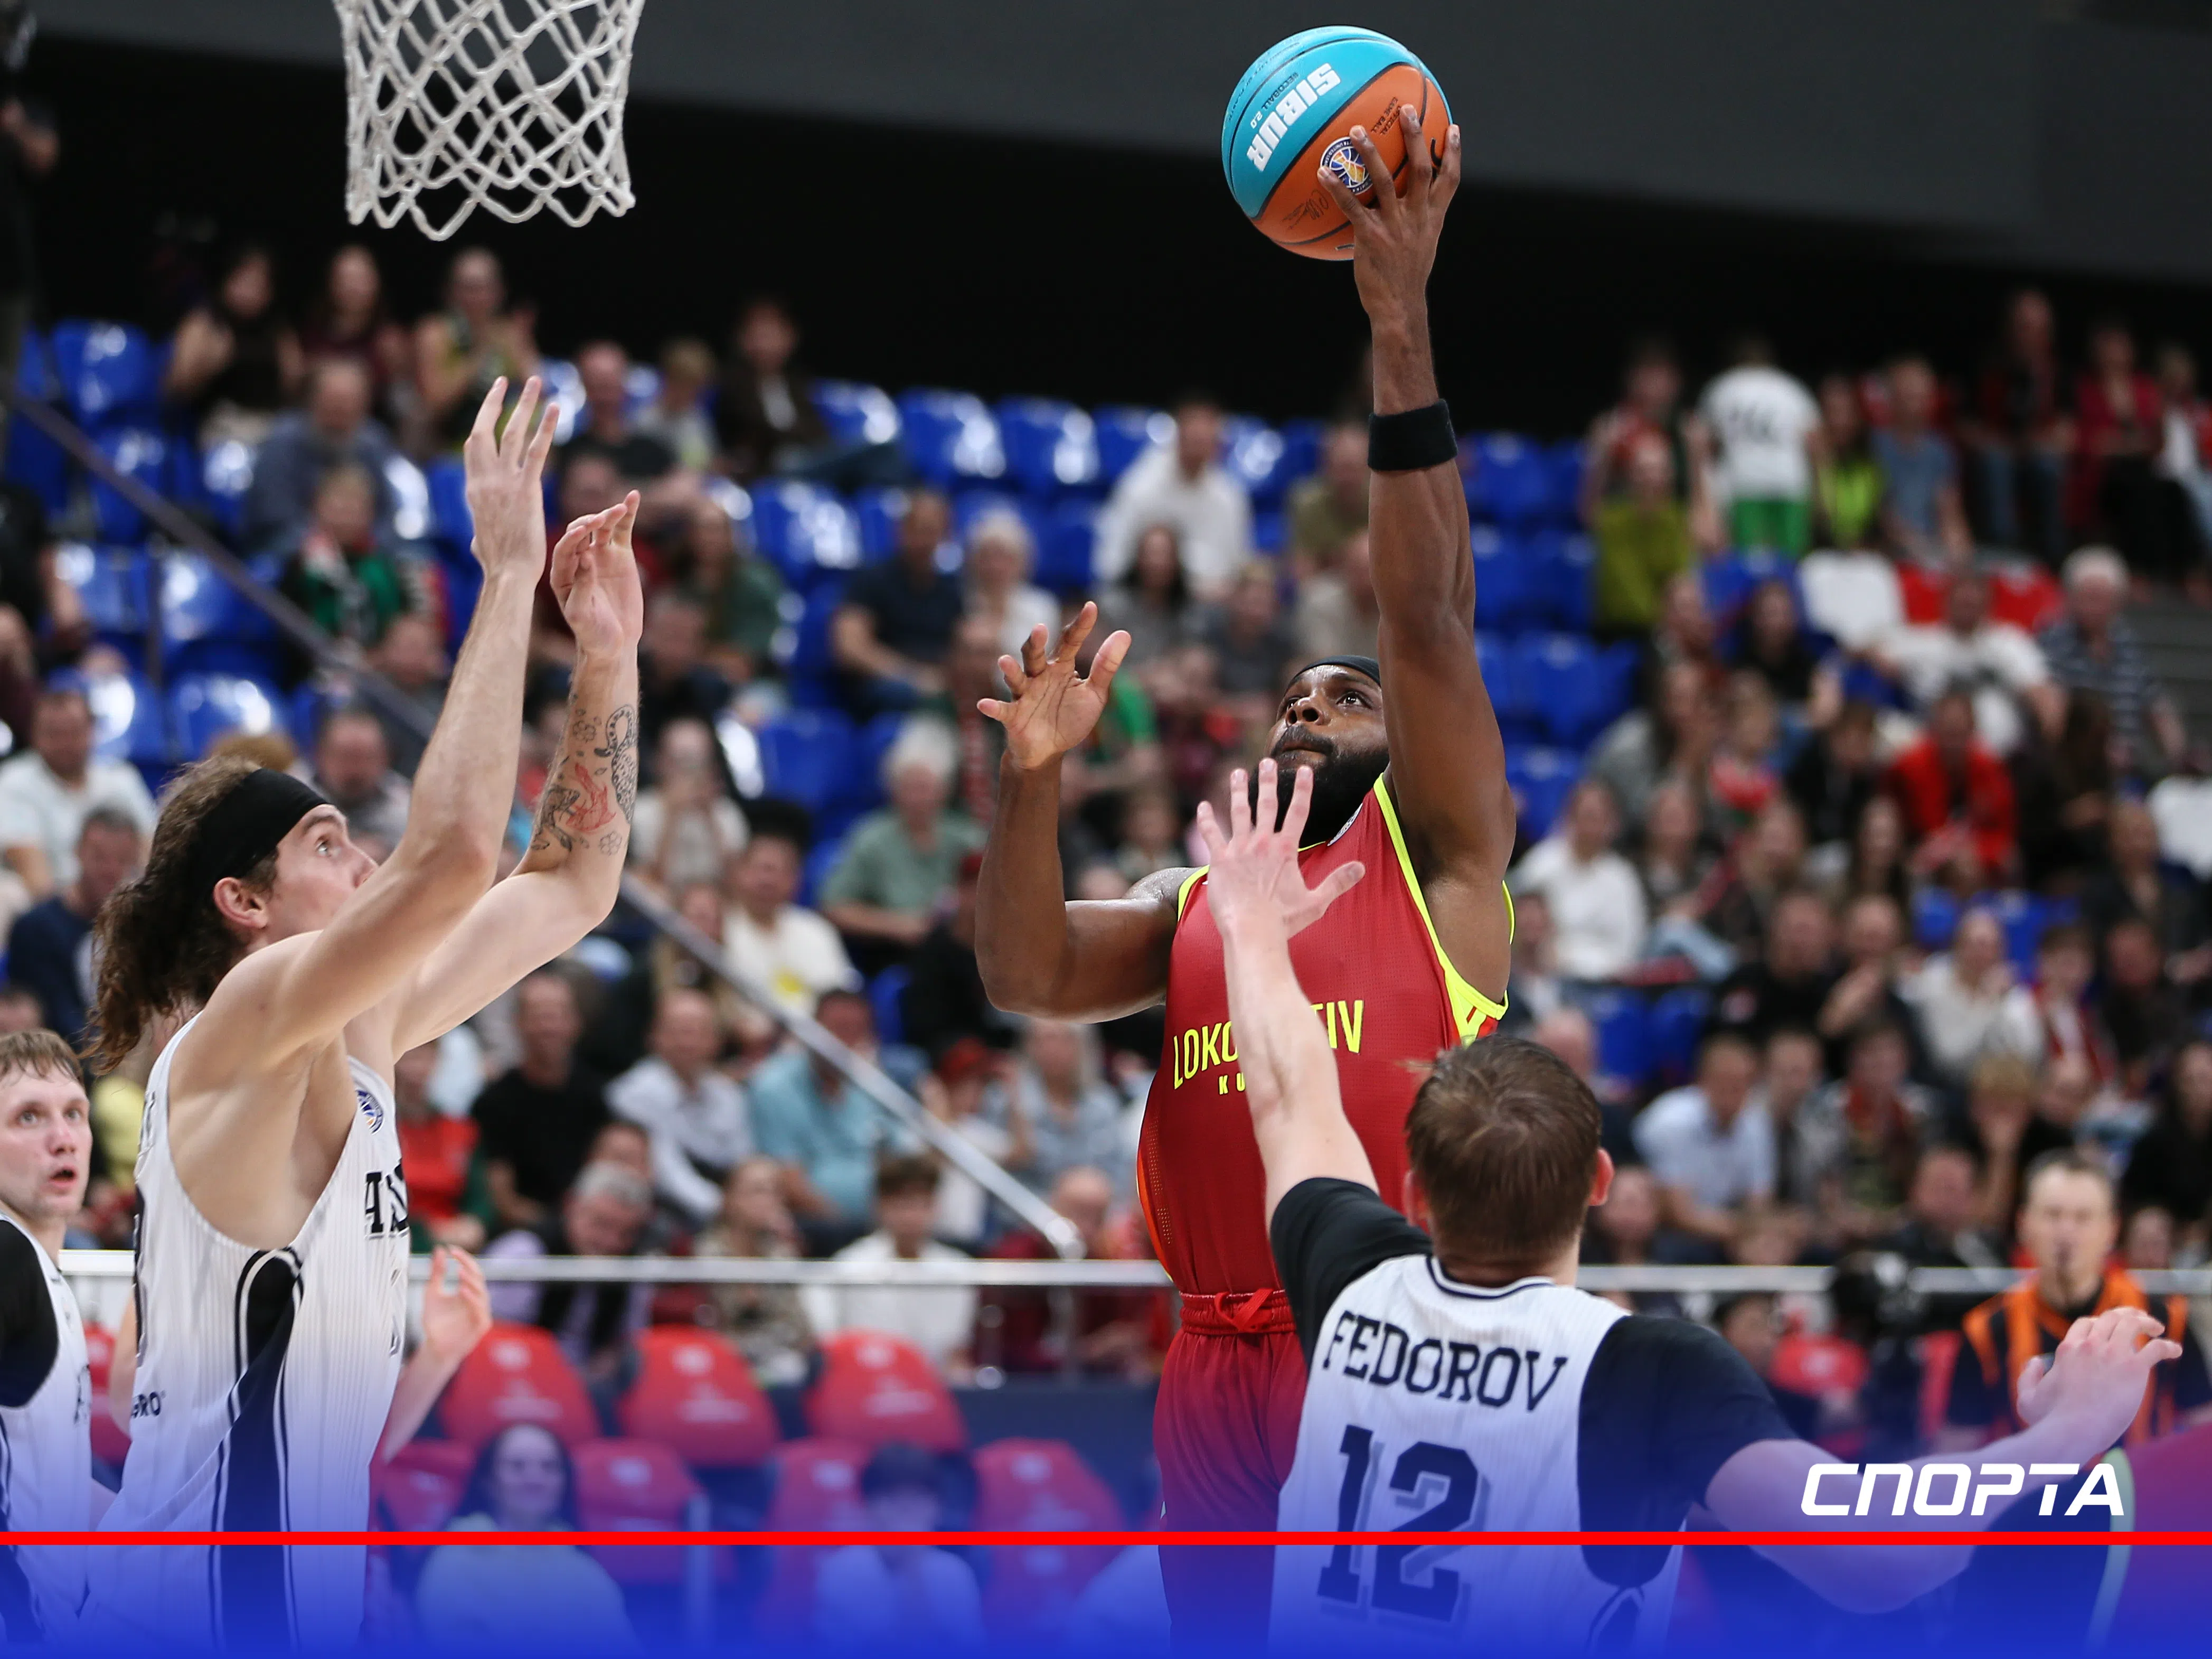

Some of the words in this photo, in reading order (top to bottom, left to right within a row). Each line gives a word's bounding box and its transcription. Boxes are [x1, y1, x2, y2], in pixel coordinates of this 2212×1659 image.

[1247, 63, 1341, 172] SIBUR
[1250, 110, 1263, 129] 2.0
[1261, 72, 1299, 110] #ECOBALL
[1371, 116, 1386, 134] BALL
[1173, 999, 1364, 1090] LOKOIV
[1322, 1310, 1568, 1411] FEDOROV
[1316, 1424, 1480, 1624] 12
